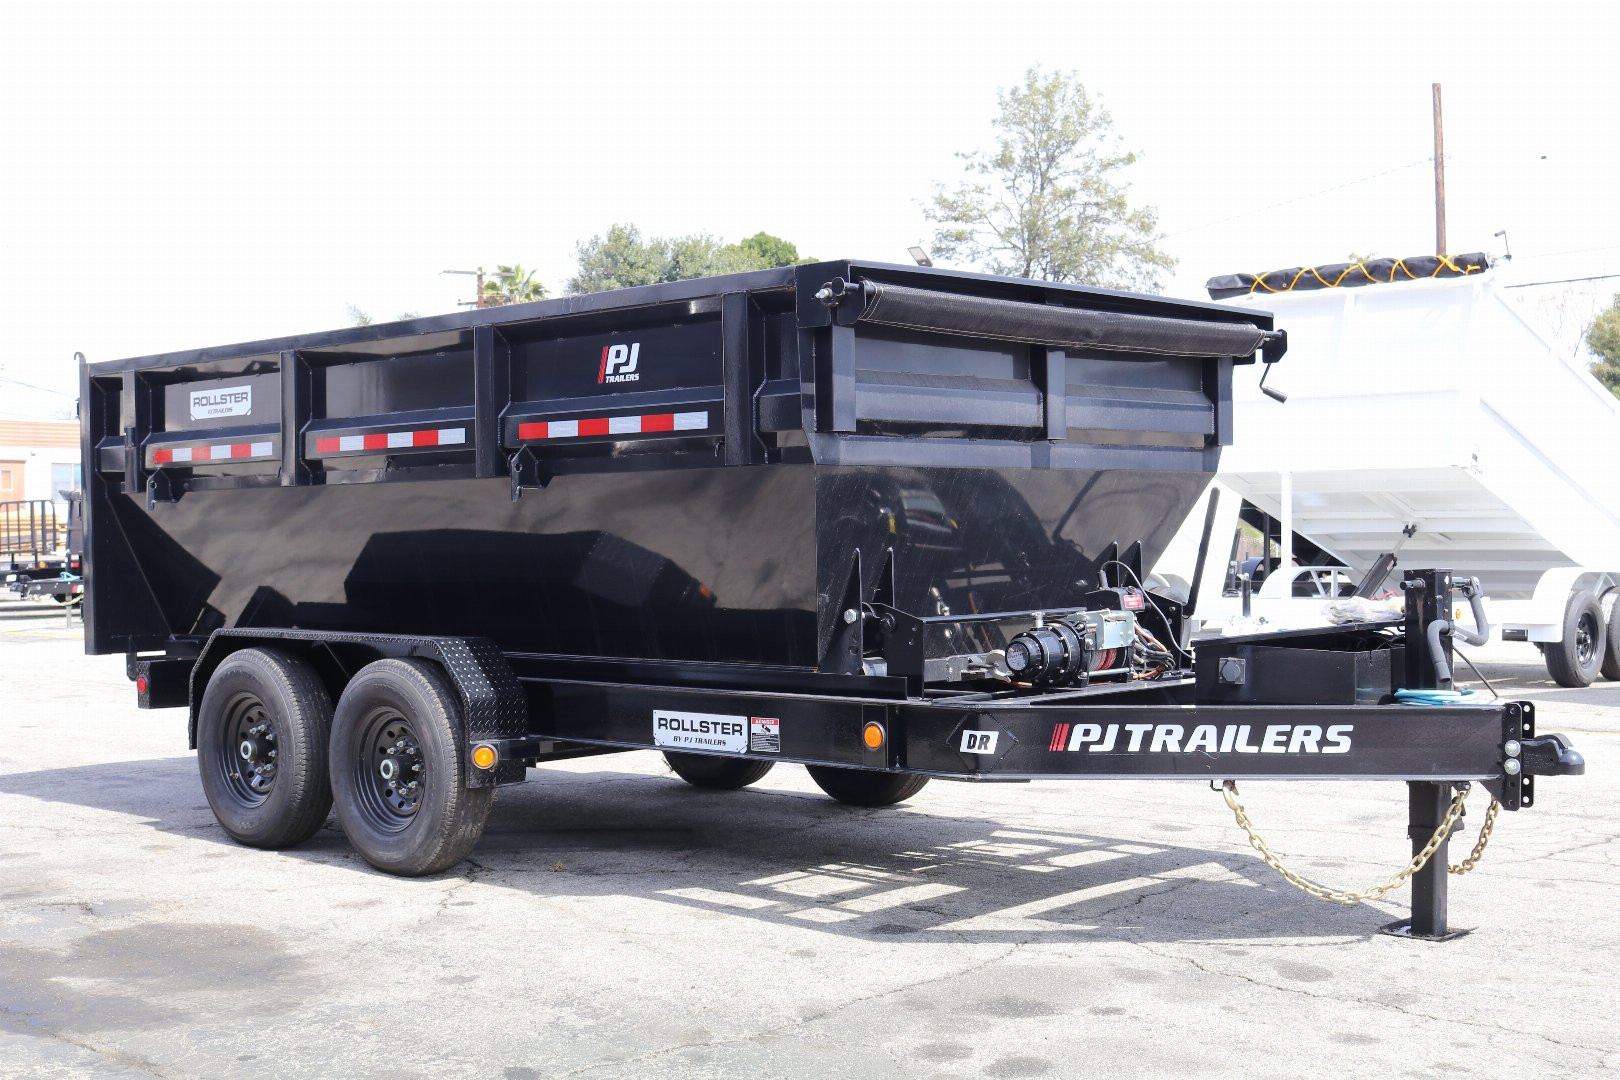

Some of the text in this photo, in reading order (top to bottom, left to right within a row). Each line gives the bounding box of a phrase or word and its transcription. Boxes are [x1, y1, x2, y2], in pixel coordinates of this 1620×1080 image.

[605, 342, 640, 375] PJ
[605, 373, 640, 384] TRAILERS
[193, 391, 249, 407] ROLLSTER
[657, 717, 743, 736] ROLLSTER
[684, 736, 693, 744] PJ
[694, 737, 727, 747] TRAILERS
[966, 733, 991, 751] DR
[1067, 723, 1354, 754] PJ TRAILERS
